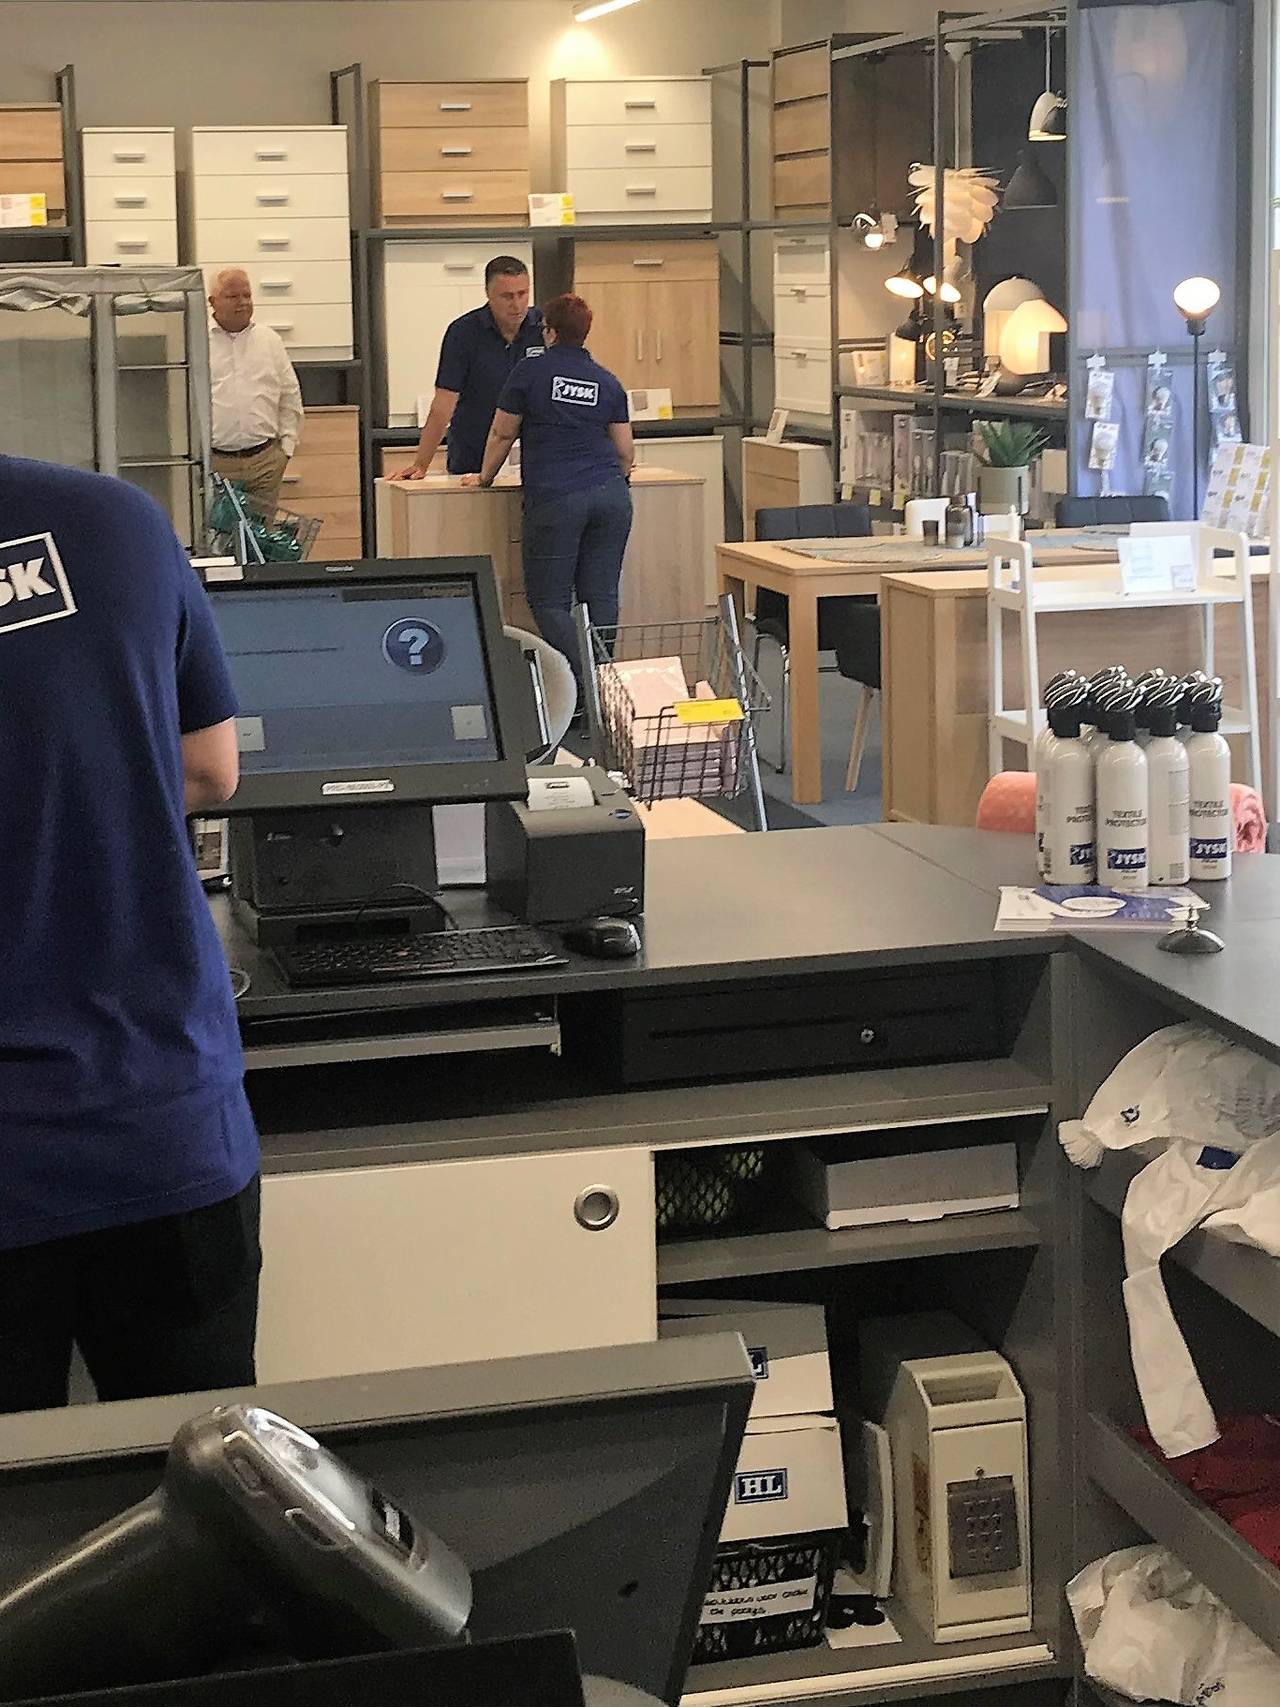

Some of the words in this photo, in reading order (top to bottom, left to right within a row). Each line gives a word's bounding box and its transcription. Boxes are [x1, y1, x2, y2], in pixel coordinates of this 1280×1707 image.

[562, 385, 595, 399] JYSK
[1196, 843, 1227, 854] JYSK
[1115, 852, 1146, 865] JYSK
[741, 1475, 782, 1497] HL
